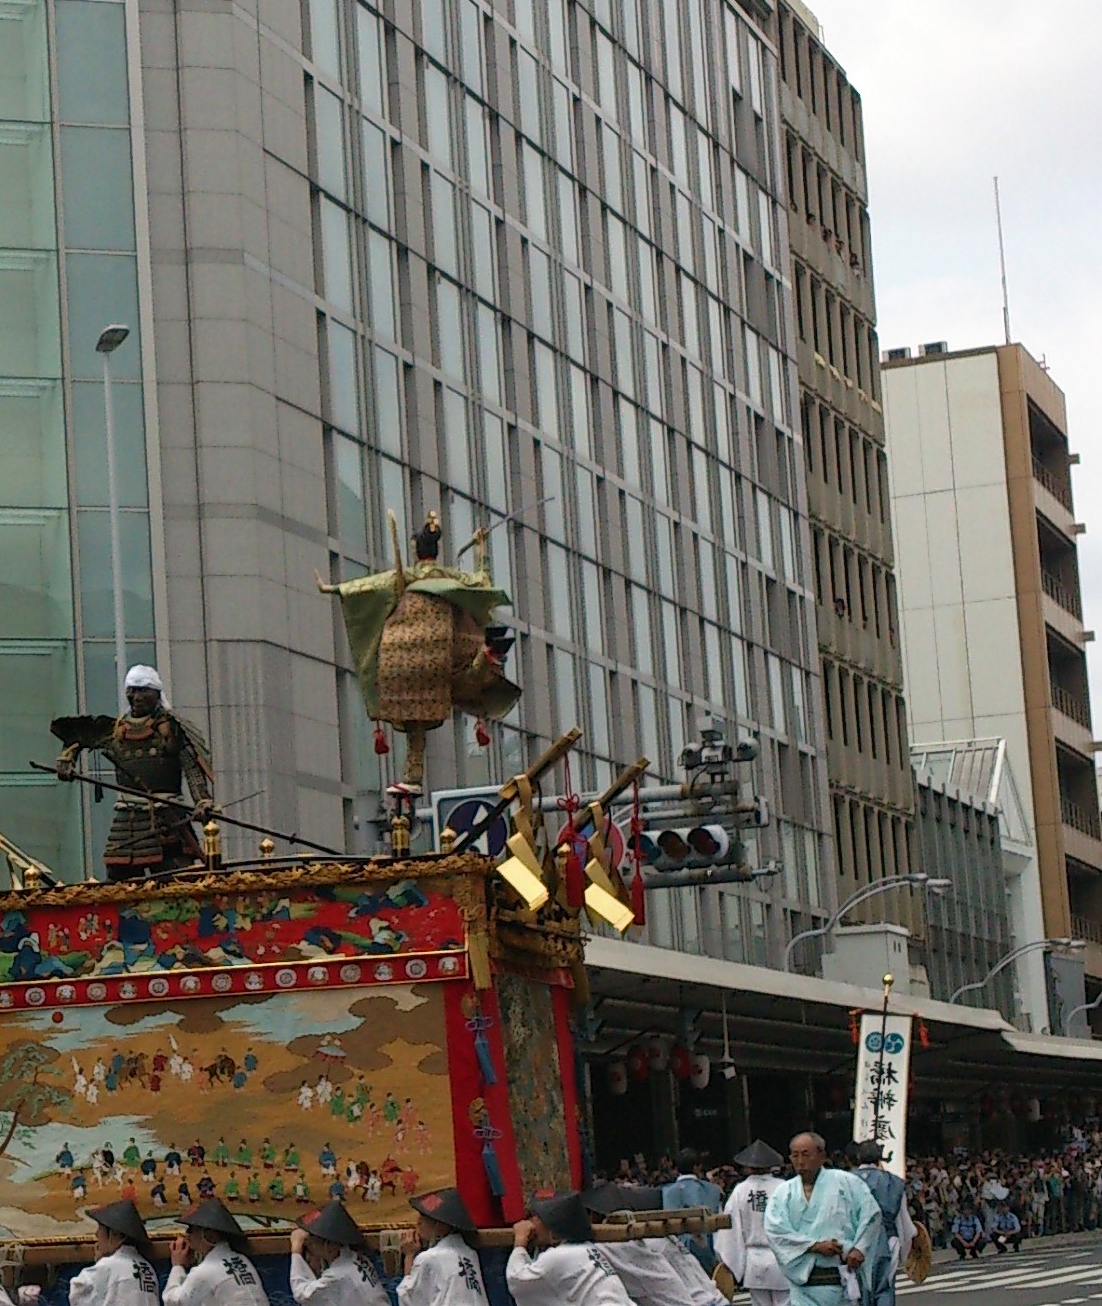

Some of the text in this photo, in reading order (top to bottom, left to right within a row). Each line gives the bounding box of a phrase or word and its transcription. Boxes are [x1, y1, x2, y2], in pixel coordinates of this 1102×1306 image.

[747, 1189, 768, 1212] 橋
[132, 1259, 157, 1293] 橋
[222, 1256, 256, 1286] 橋
